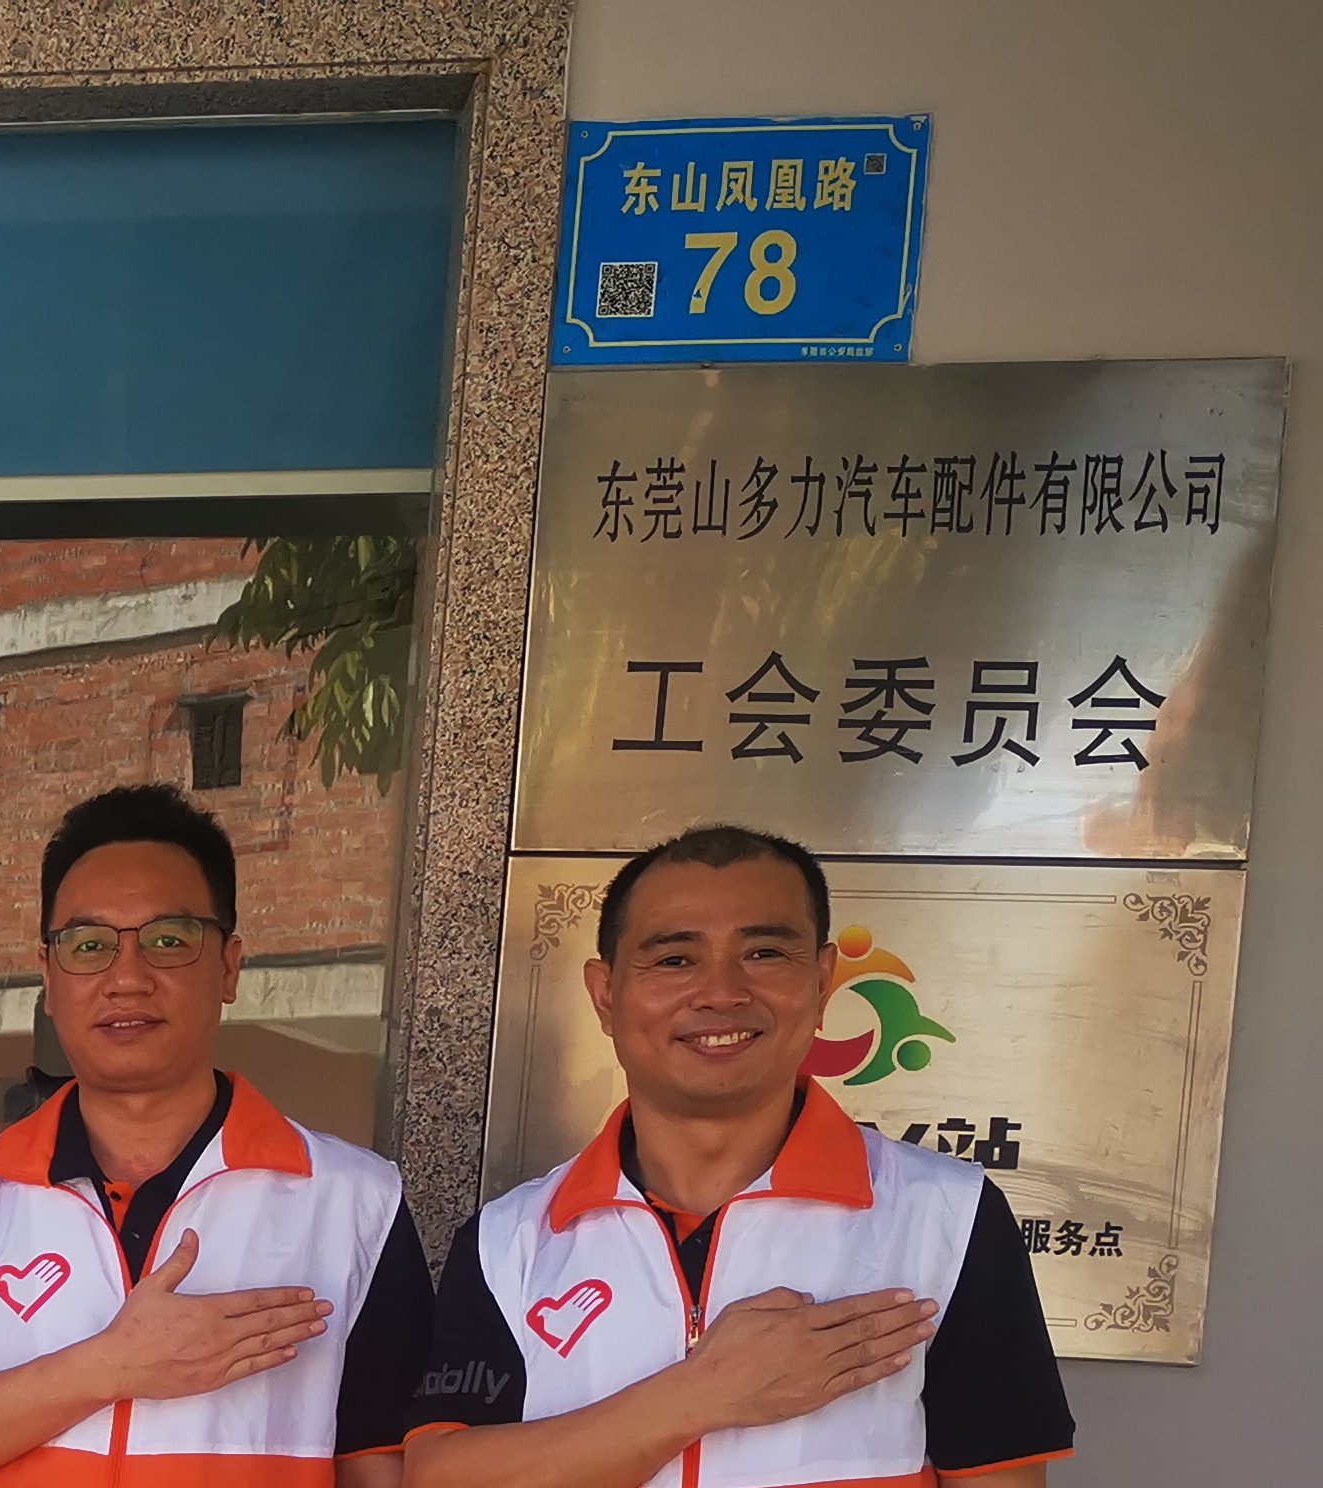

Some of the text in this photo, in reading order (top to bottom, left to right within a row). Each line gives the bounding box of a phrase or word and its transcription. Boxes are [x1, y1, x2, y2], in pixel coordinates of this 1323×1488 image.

[620, 157, 857, 216] 东山凤凰路
[683, 229, 798, 315] 78
[592, 448, 1228, 543] 东莞山多力汽车配件有限公司
[611, 650, 1167, 771] 工会委员会
